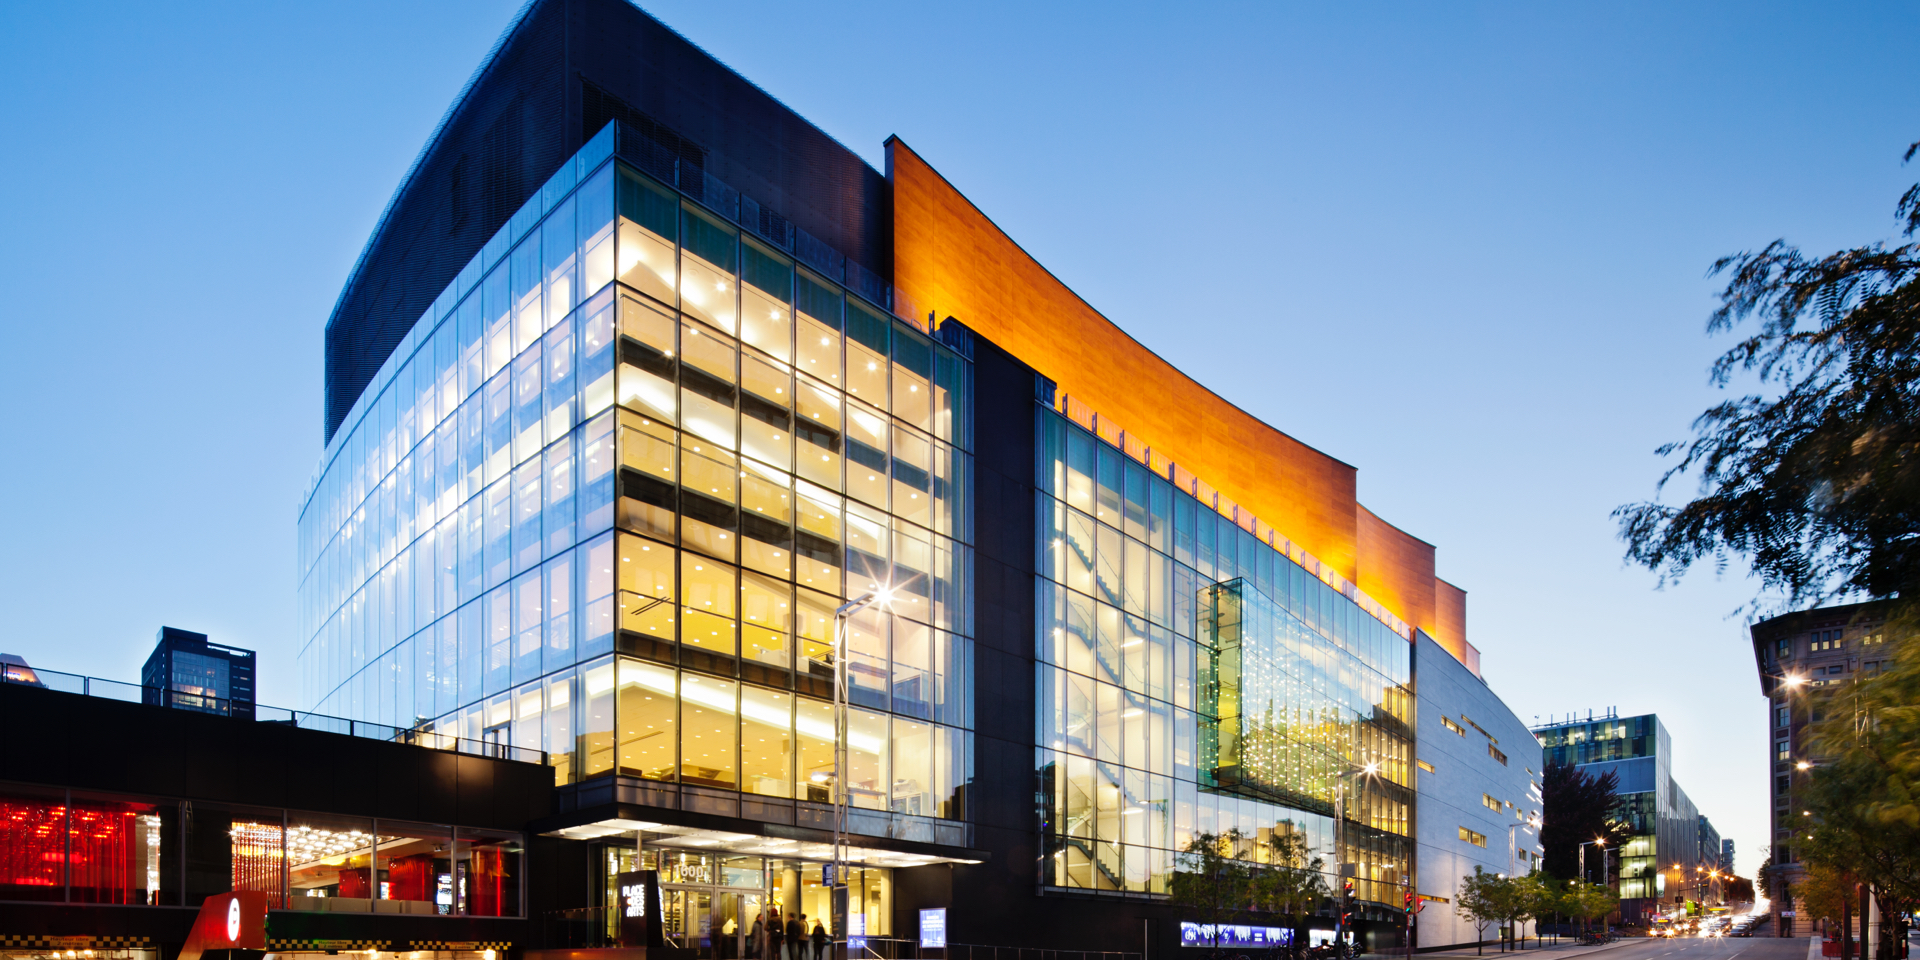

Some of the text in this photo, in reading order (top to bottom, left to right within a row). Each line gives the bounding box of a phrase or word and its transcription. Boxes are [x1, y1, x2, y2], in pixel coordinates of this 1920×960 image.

[673, 864, 704, 878] 1600
[622, 884, 645, 897] PLACE
[630, 896, 645, 907] DES
[626, 905, 645, 917] ARTS
